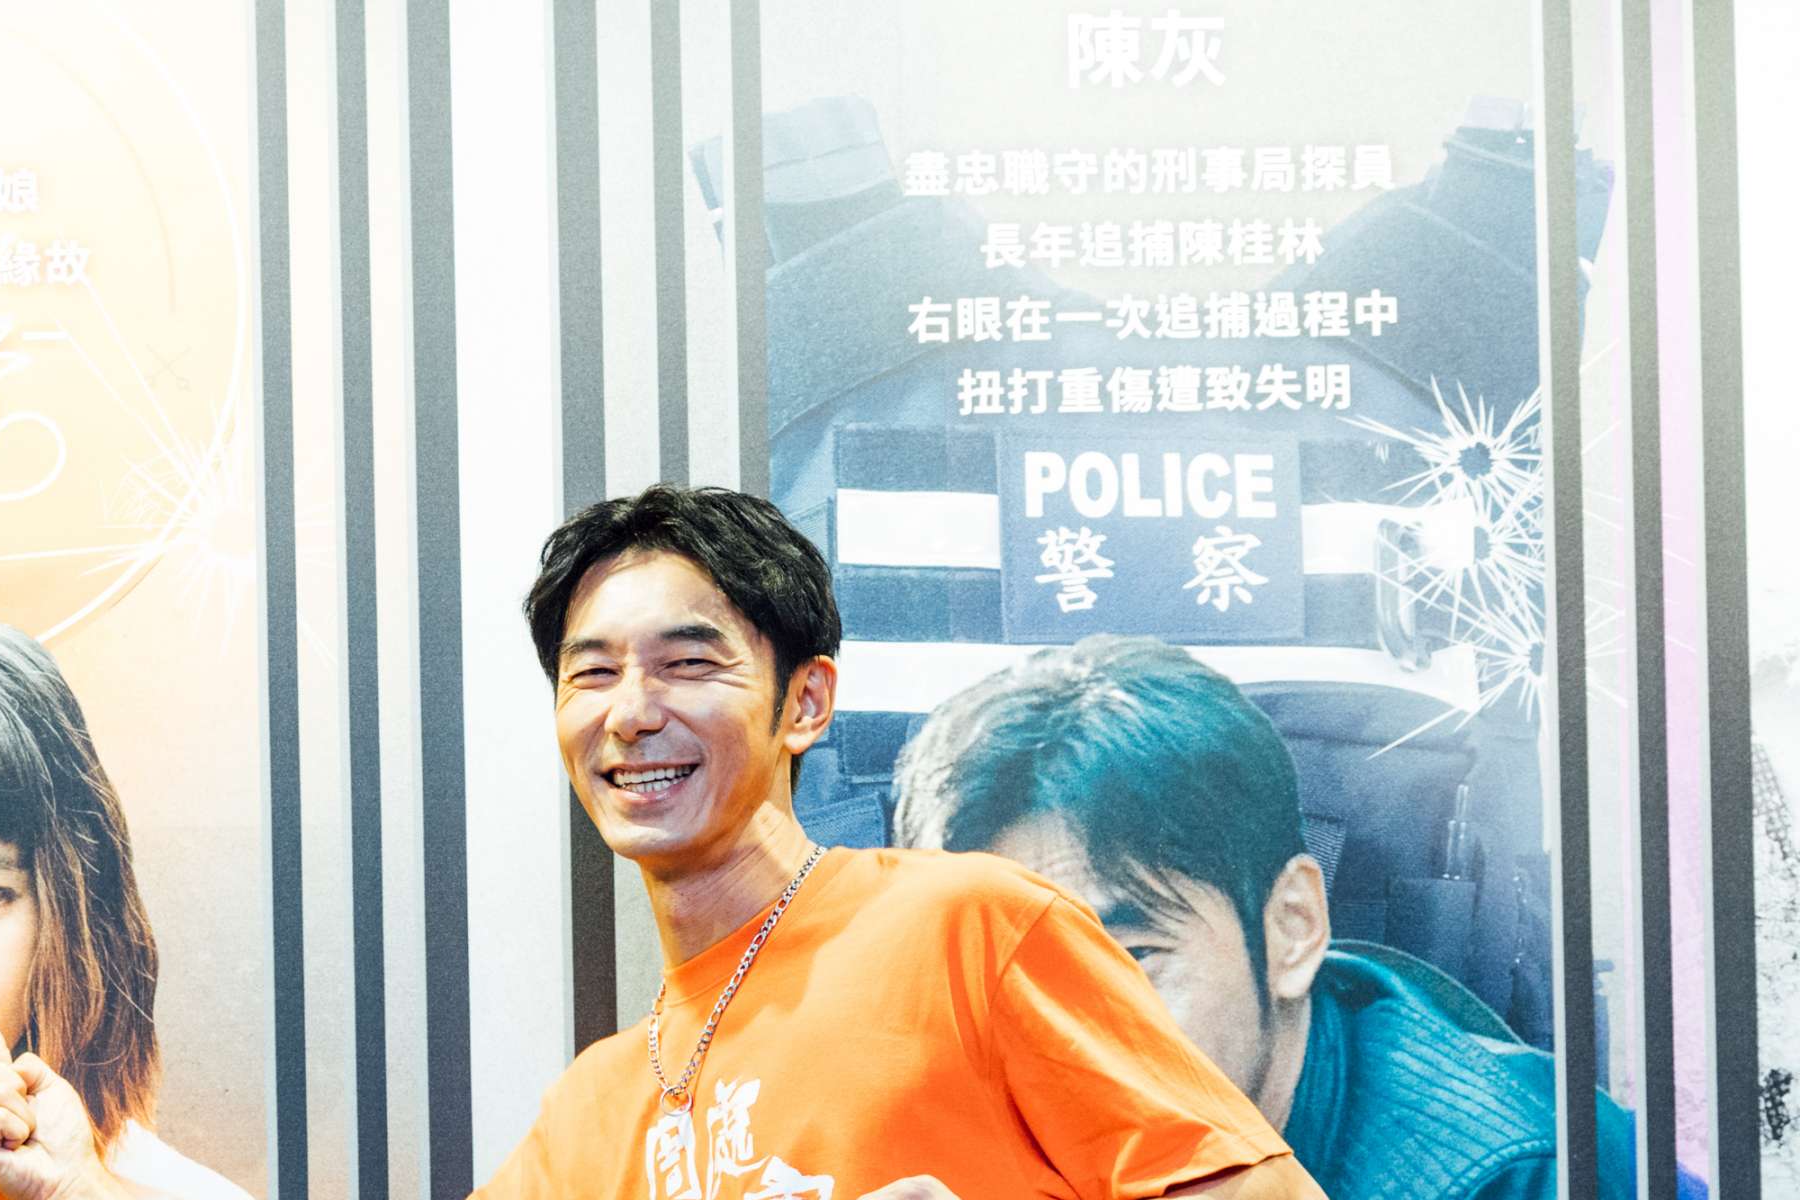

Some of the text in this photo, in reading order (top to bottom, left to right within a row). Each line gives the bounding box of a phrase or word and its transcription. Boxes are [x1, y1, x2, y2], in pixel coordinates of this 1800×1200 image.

[1068, 12, 1225, 89] 陳灰
[903, 144, 1395, 197] 盡忠職守的刑事局探員
[980, 217, 1324, 270] 長年追捕陳桂林
[908, 289, 1399, 344] 右眼在一次追捕過程中
[958, 364, 1352, 418] 扭打重傷遭致失明
[1025, 452, 1276, 519] POLICE
